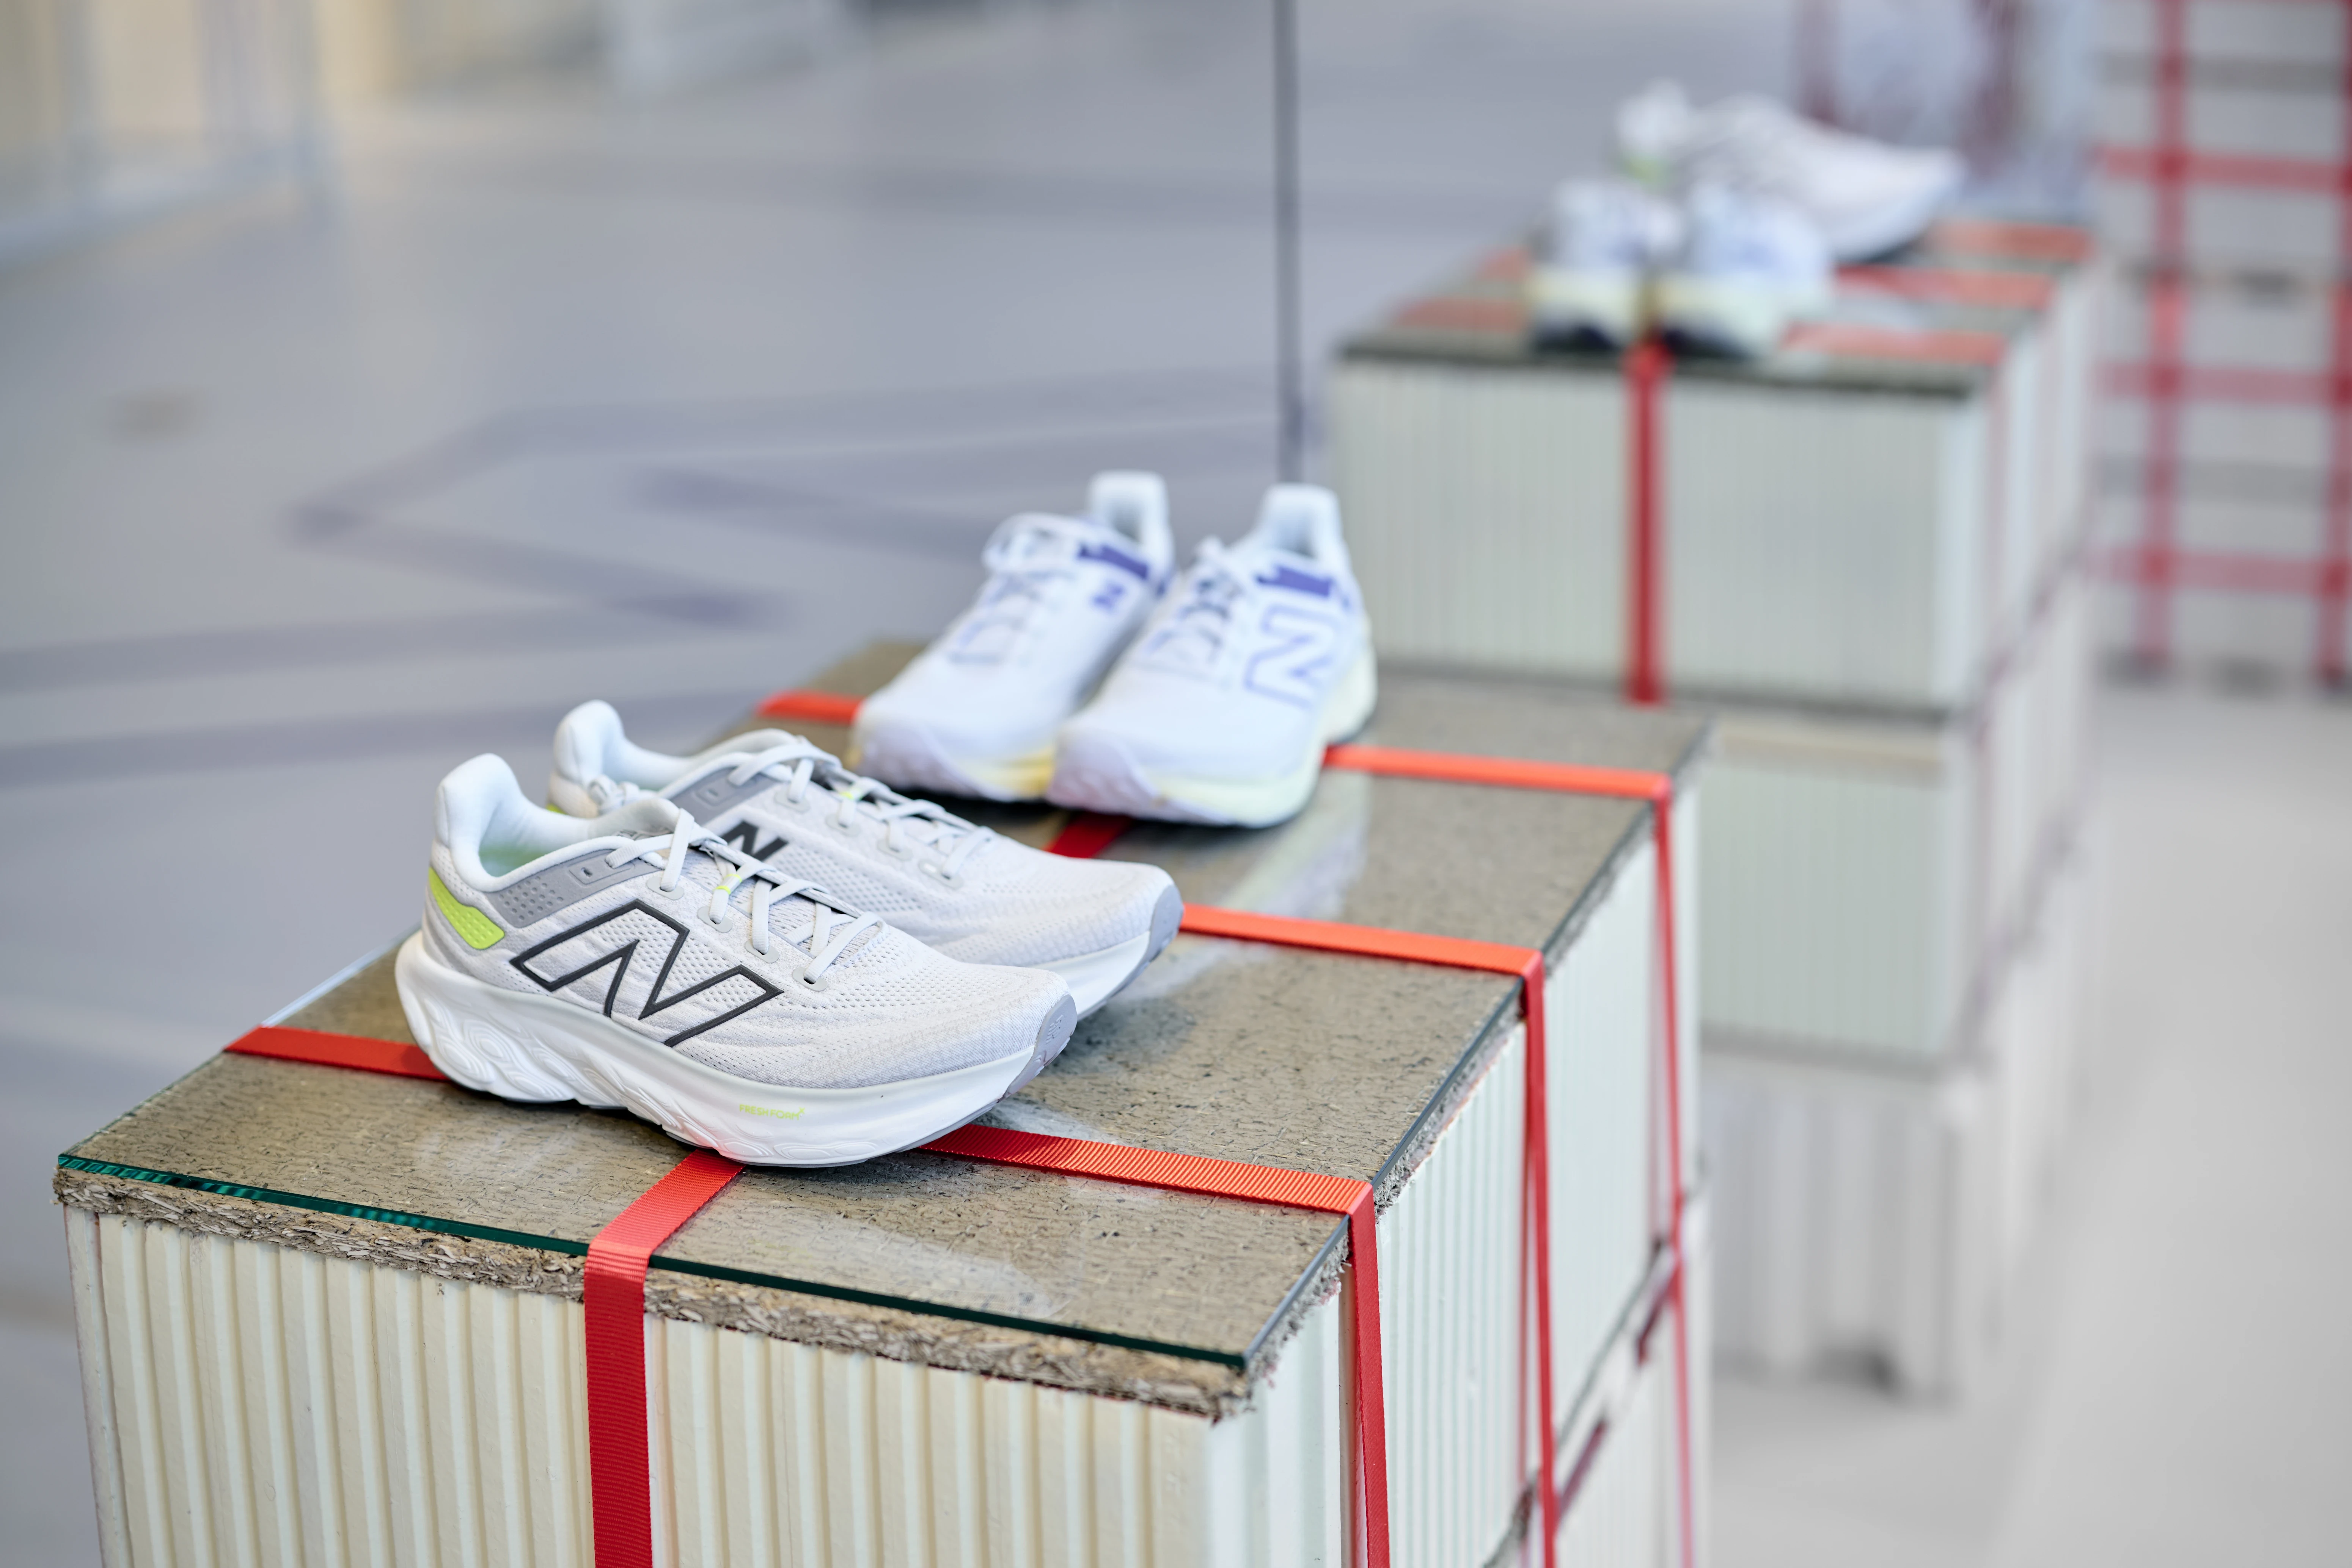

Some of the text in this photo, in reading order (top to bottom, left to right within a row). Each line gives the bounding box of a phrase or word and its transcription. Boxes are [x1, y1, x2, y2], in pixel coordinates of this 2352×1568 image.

[1243, 604, 1338, 710] N
[720, 820, 789, 862] N
[509, 899, 784, 1048] N
[739, 1104, 768, 1117] FRESH
